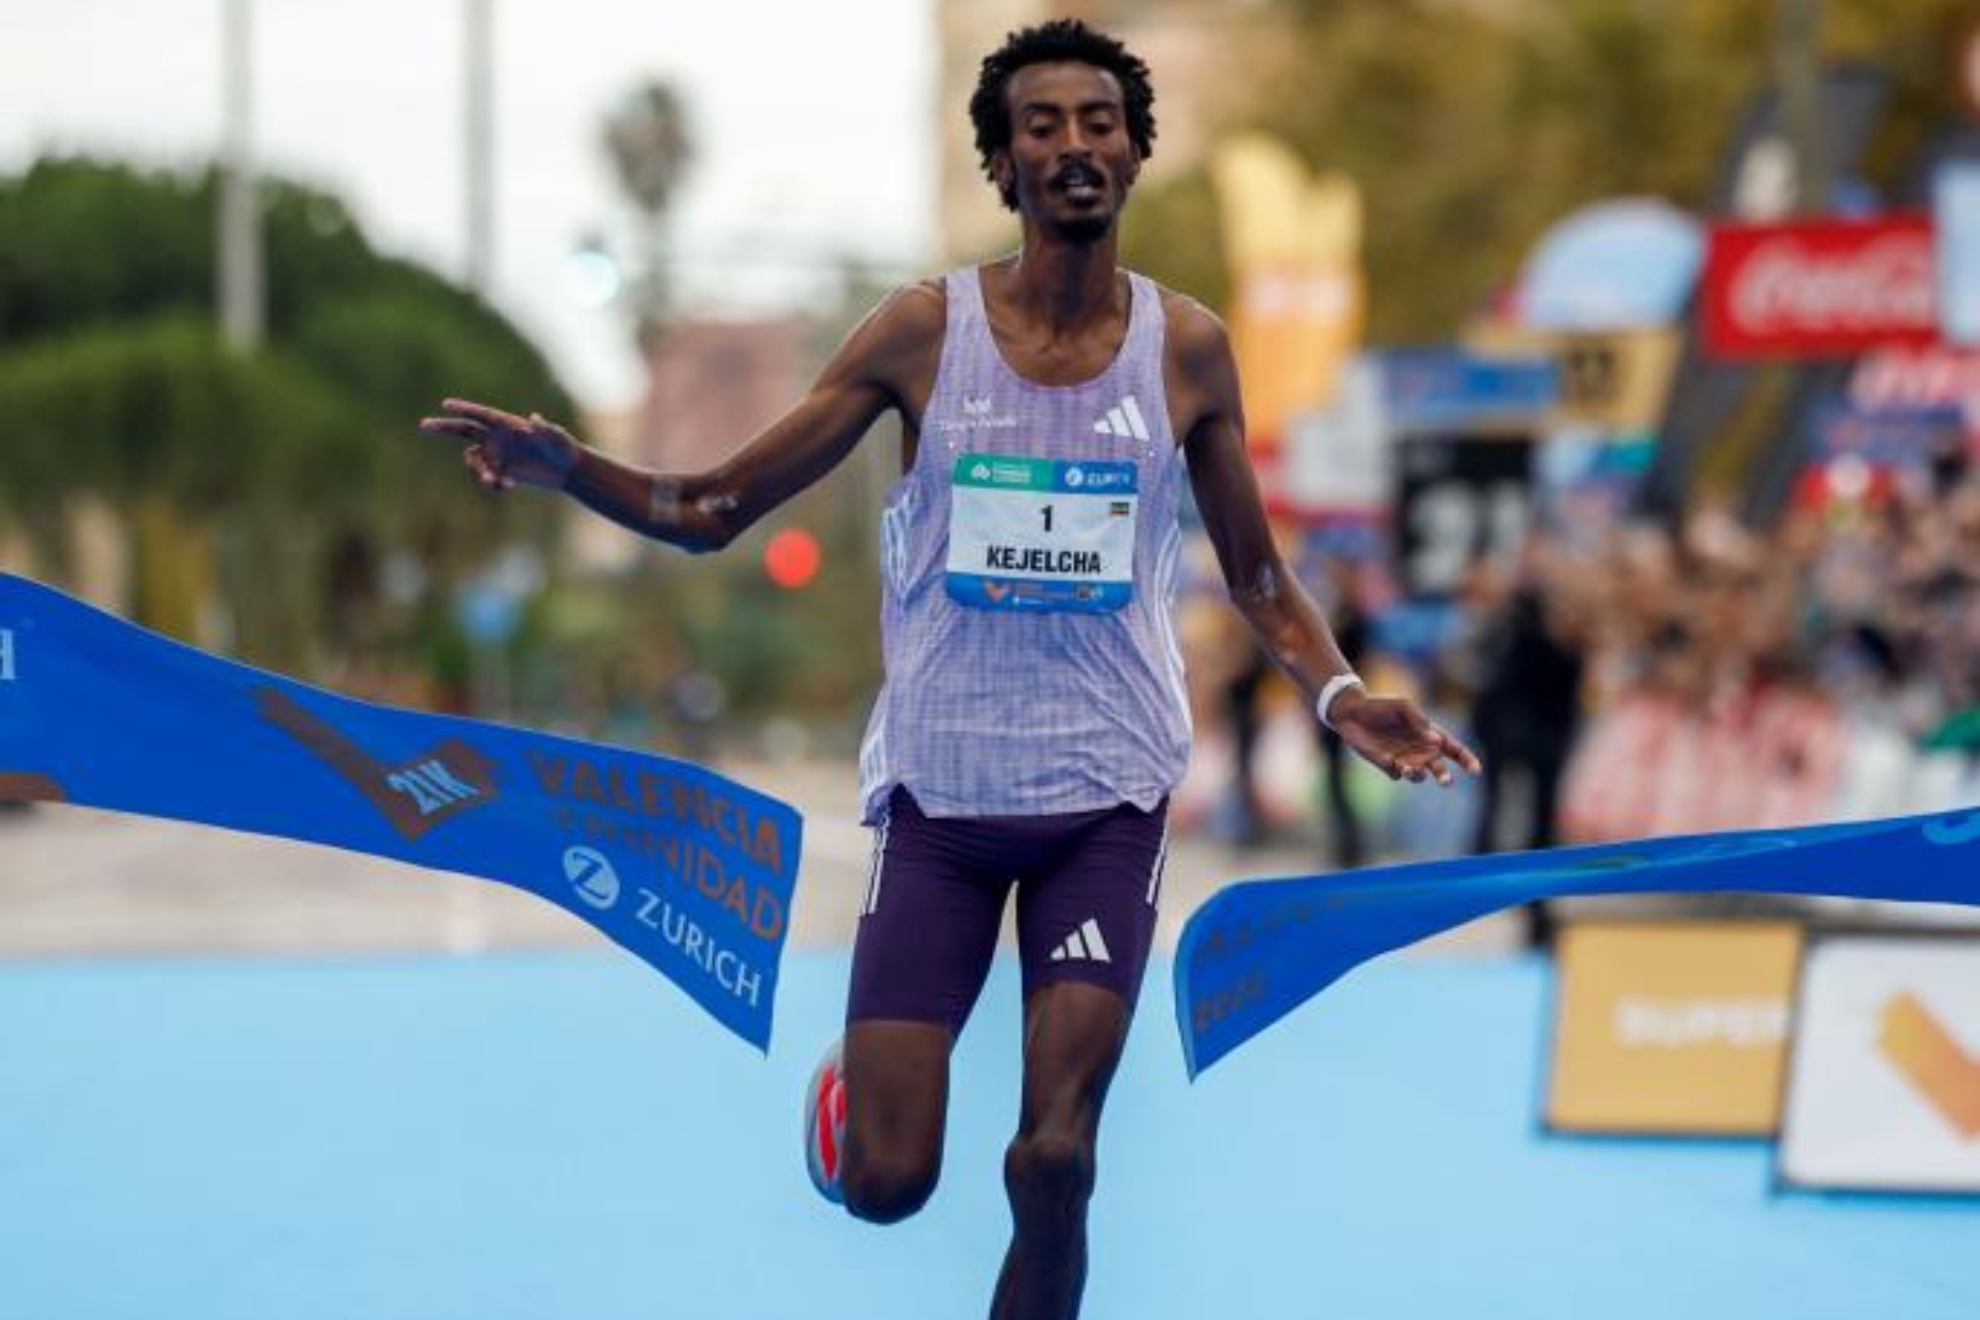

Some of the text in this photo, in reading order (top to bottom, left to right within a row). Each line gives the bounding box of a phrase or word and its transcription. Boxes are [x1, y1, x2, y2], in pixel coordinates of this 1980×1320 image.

[1040, 504, 1054, 532] 1
[986, 544, 1102, 574] KEJELCHA
[523, 748, 784, 877] VALENCIA
[635, 887, 762, 1007] ZURICH
